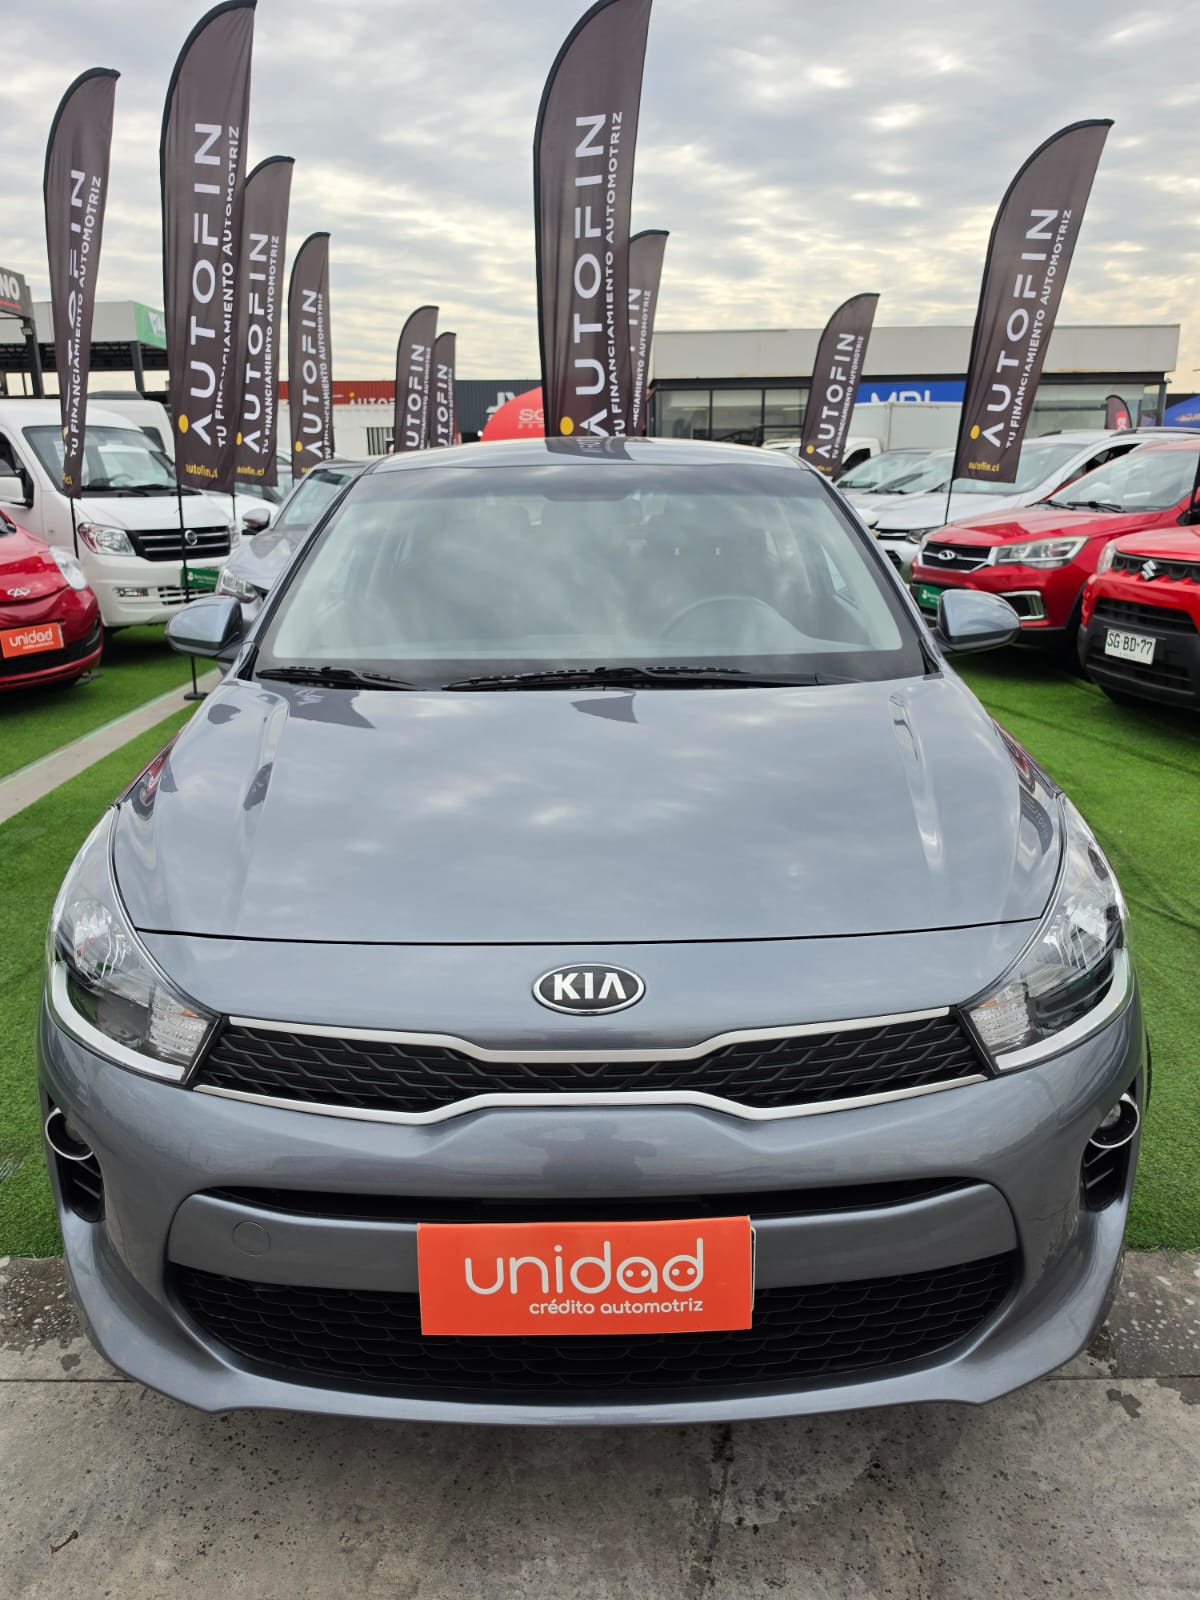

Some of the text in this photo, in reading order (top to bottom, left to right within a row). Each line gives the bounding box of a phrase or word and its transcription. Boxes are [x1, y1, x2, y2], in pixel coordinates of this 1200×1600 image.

[605, 111, 623, 244] AUTOMOTRIZ
[70, 175, 102, 457] TU FINANCIAMIENTO AUTOMOTRIZ
[190, 122, 223, 446] AUTOFIN
[215, 426, 227, 448] TU
[222, 125, 240, 256] AUTOMOTRIZ
[243, 233, 269, 453] AUTOFIN
[261, 235, 280, 454] TU FINANCIAMIENTO AUTOMOTRIZ
[317, 293, 328, 360] AUTOMOTRIZ
[574, 114, 609, 437] AUTOFIN
[605, 251, 623, 414] FINANCIAMIENTO
[640, 290, 652, 358] AUTOMOTRIZ
[982, 209, 1059, 448] AUTOFIN
[1005, 209, 1072, 449] TU FINANCIAMIENTO AUTOMOTRIZ
[302, 289, 324, 459] AUTOFIN
[816, 333, 856, 459] AUTOFIN
[9, 626, 53, 647] unidad
[553, 972, 626, 1000] KIA
[465, 1237, 704, 1295] unidad
[529, 1297, 703, 1315] crédito automotriz
